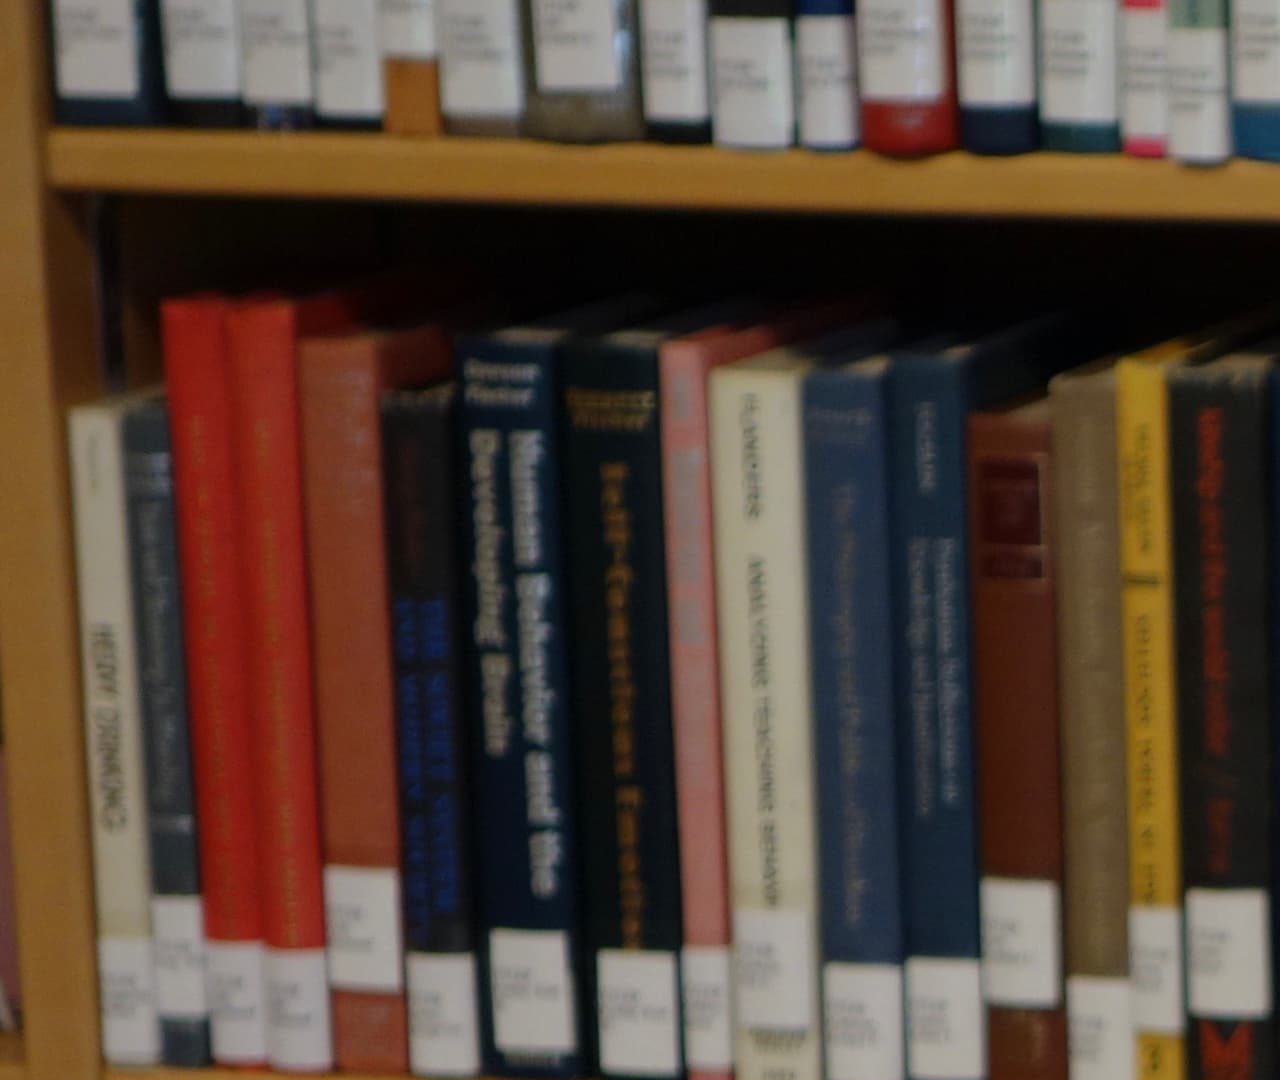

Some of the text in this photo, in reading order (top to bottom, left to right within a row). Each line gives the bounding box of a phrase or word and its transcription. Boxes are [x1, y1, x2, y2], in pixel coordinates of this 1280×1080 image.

[468, 427, 514, 756] Developing Brain
[507, 428, 564, 898] Human Behavior and the
